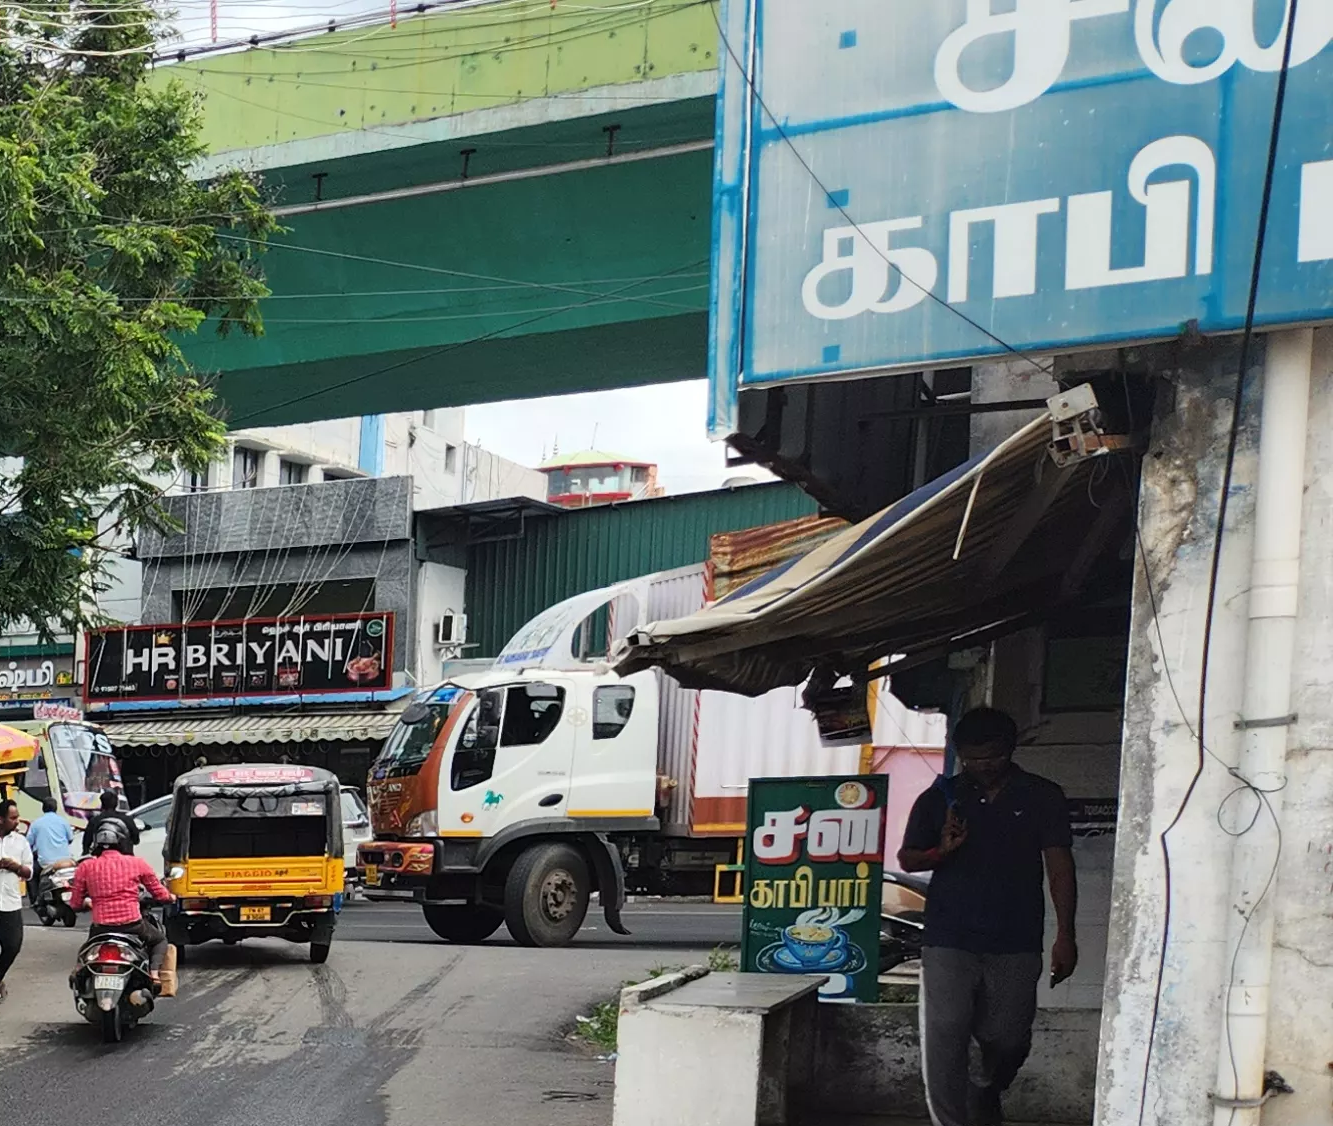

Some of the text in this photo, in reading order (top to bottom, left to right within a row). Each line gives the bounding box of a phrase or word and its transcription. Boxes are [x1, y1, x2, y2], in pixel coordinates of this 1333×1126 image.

[801, 135, 1215, 320] காபி
[126, 637, 344, 675] HR BRIYANI
[753, 781, 882, 862] சன்
[224, 869, 272, 878] PIAGGIO
[749, 861, 871, 909] காபி பார்
